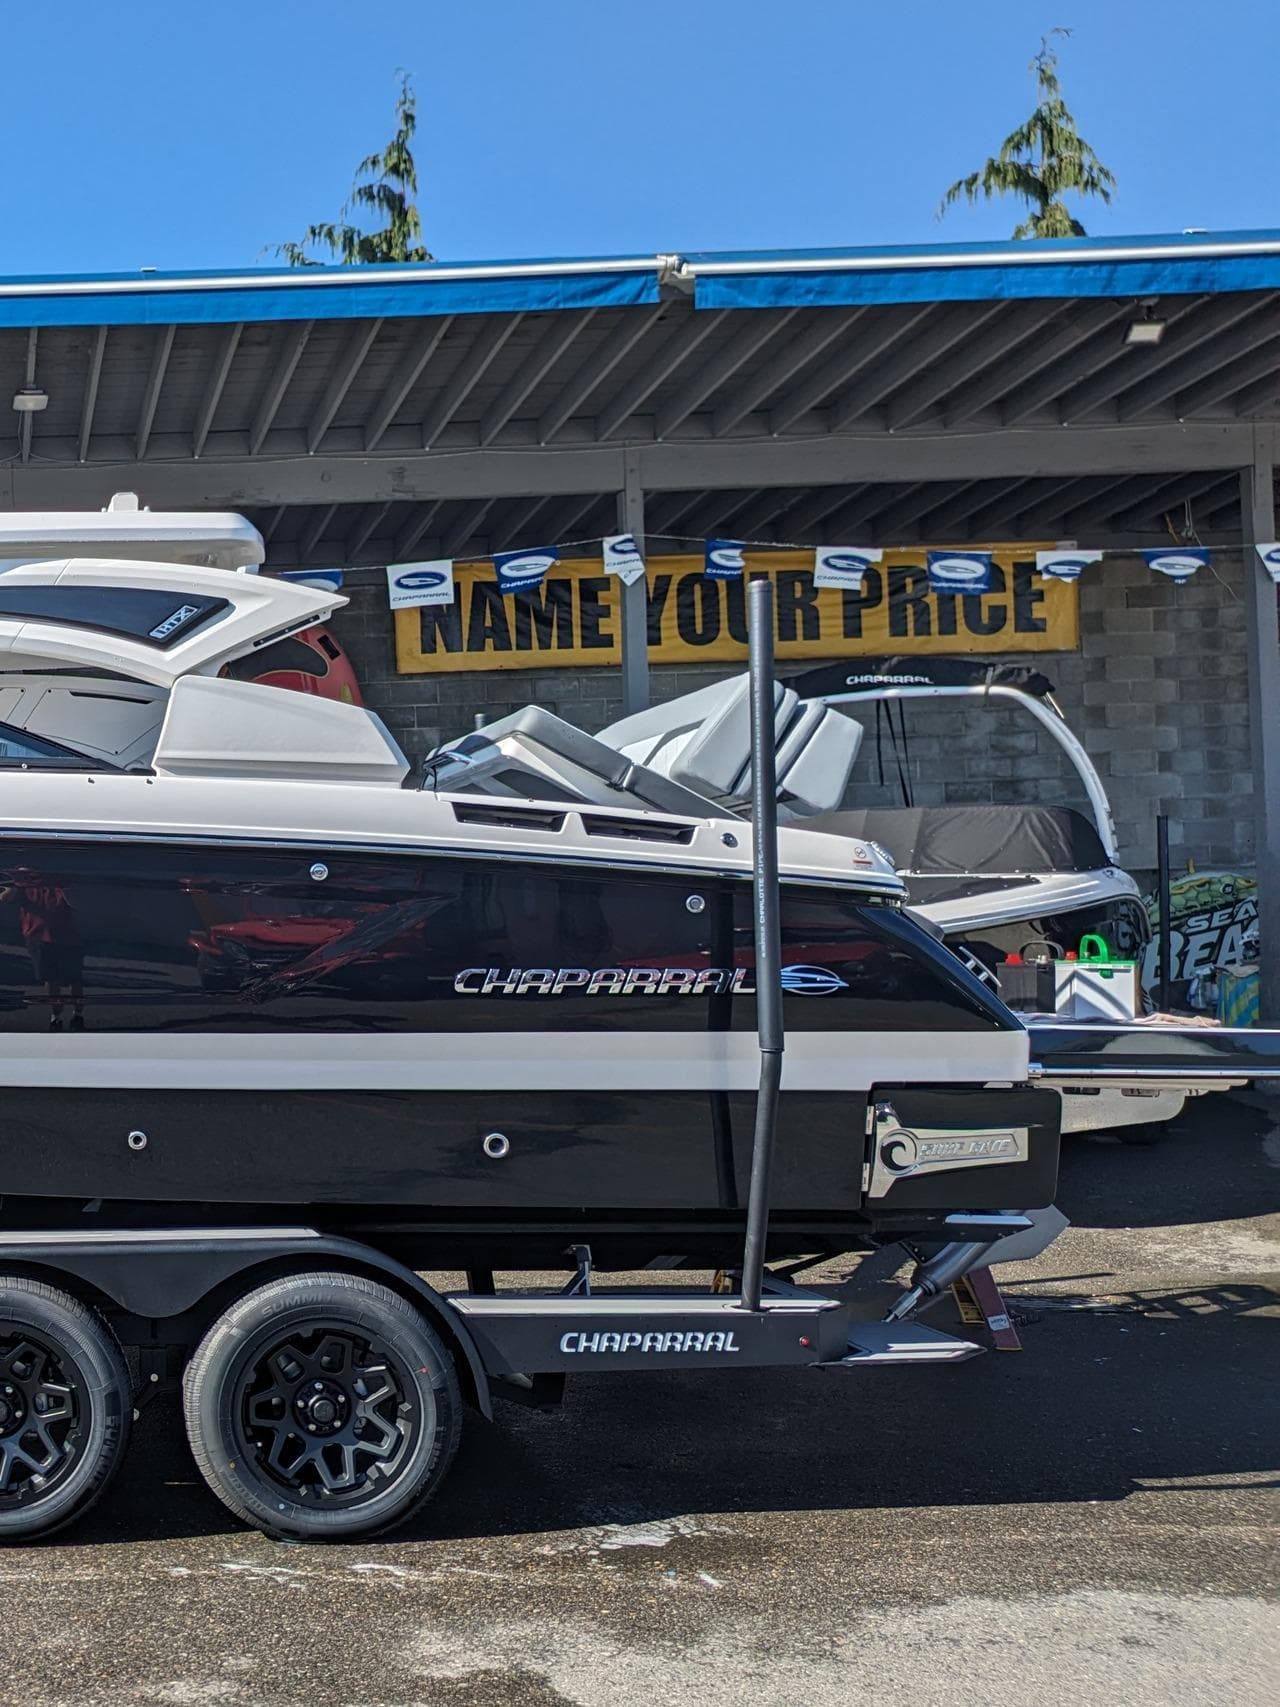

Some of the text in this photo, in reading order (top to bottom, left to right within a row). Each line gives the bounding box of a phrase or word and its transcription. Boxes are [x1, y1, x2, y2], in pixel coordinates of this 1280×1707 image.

[392, 591, 451, 602] CHAPARRAL
[420, 561, 1047, 654] NAME YOUR PRICE
[845, 674, 935, 685] CHAPARRAL
[1185, 900, 1259, 934] SEA
[1141, 919, 1260, 992] BEA
[454, 967, 757, 995] CHAPARRAL
[559, 1331, 740, 1353] CHAPARRAL
